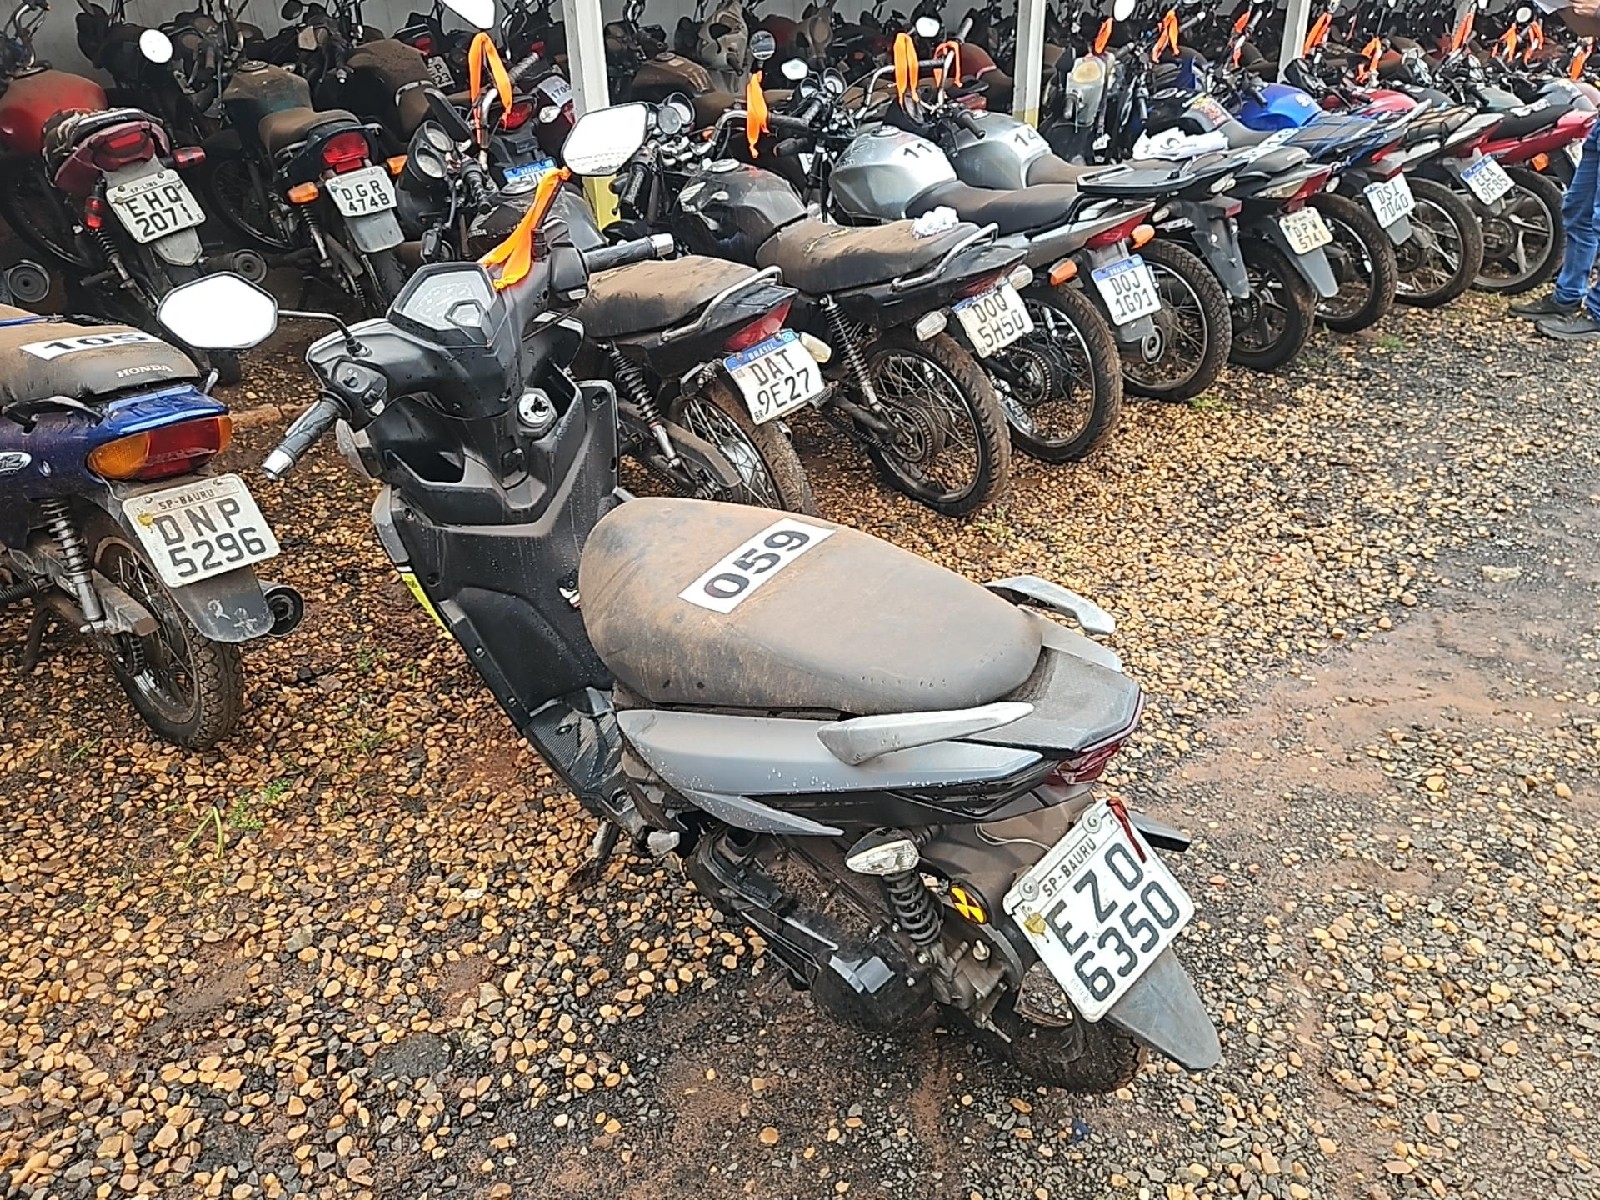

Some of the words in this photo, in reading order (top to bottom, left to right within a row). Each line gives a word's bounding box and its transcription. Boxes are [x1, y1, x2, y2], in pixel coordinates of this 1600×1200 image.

[341, 180, 383, 200] DGR
[1376, 181, 1400, 204] DSI
[1473, 167, 1496, 187] EEA
[126, 185, 183, 218] EHQ
[135, 203, 193, 238] 2071
[1109, 270, 1141, 295] DOJ
[972, 292, 1008, 323] DOQ
[1115, 287, 1153, 317] 1G91
[45, 333, 149, 350] 105
[977, 309, 1024, 348] 5H50
[747, 343, 777, 361] BRASIL
[748, 348, 795, 387] DAT
[116, 364, 174, 379] HONDA
[757, 367, 809, 415] 9E27
[158, 488, 215, 510] SP-BAURU
[153, 497, 241, 546] DNP
[168, 526, 267, 578] 5296
[703, 530, 810, 599] 059
[1042, 837, 1097, 898] SP-BAURU
[1045, 842, 1144, 956] EZO
[1074, 880, 1180, 1002] 6350
